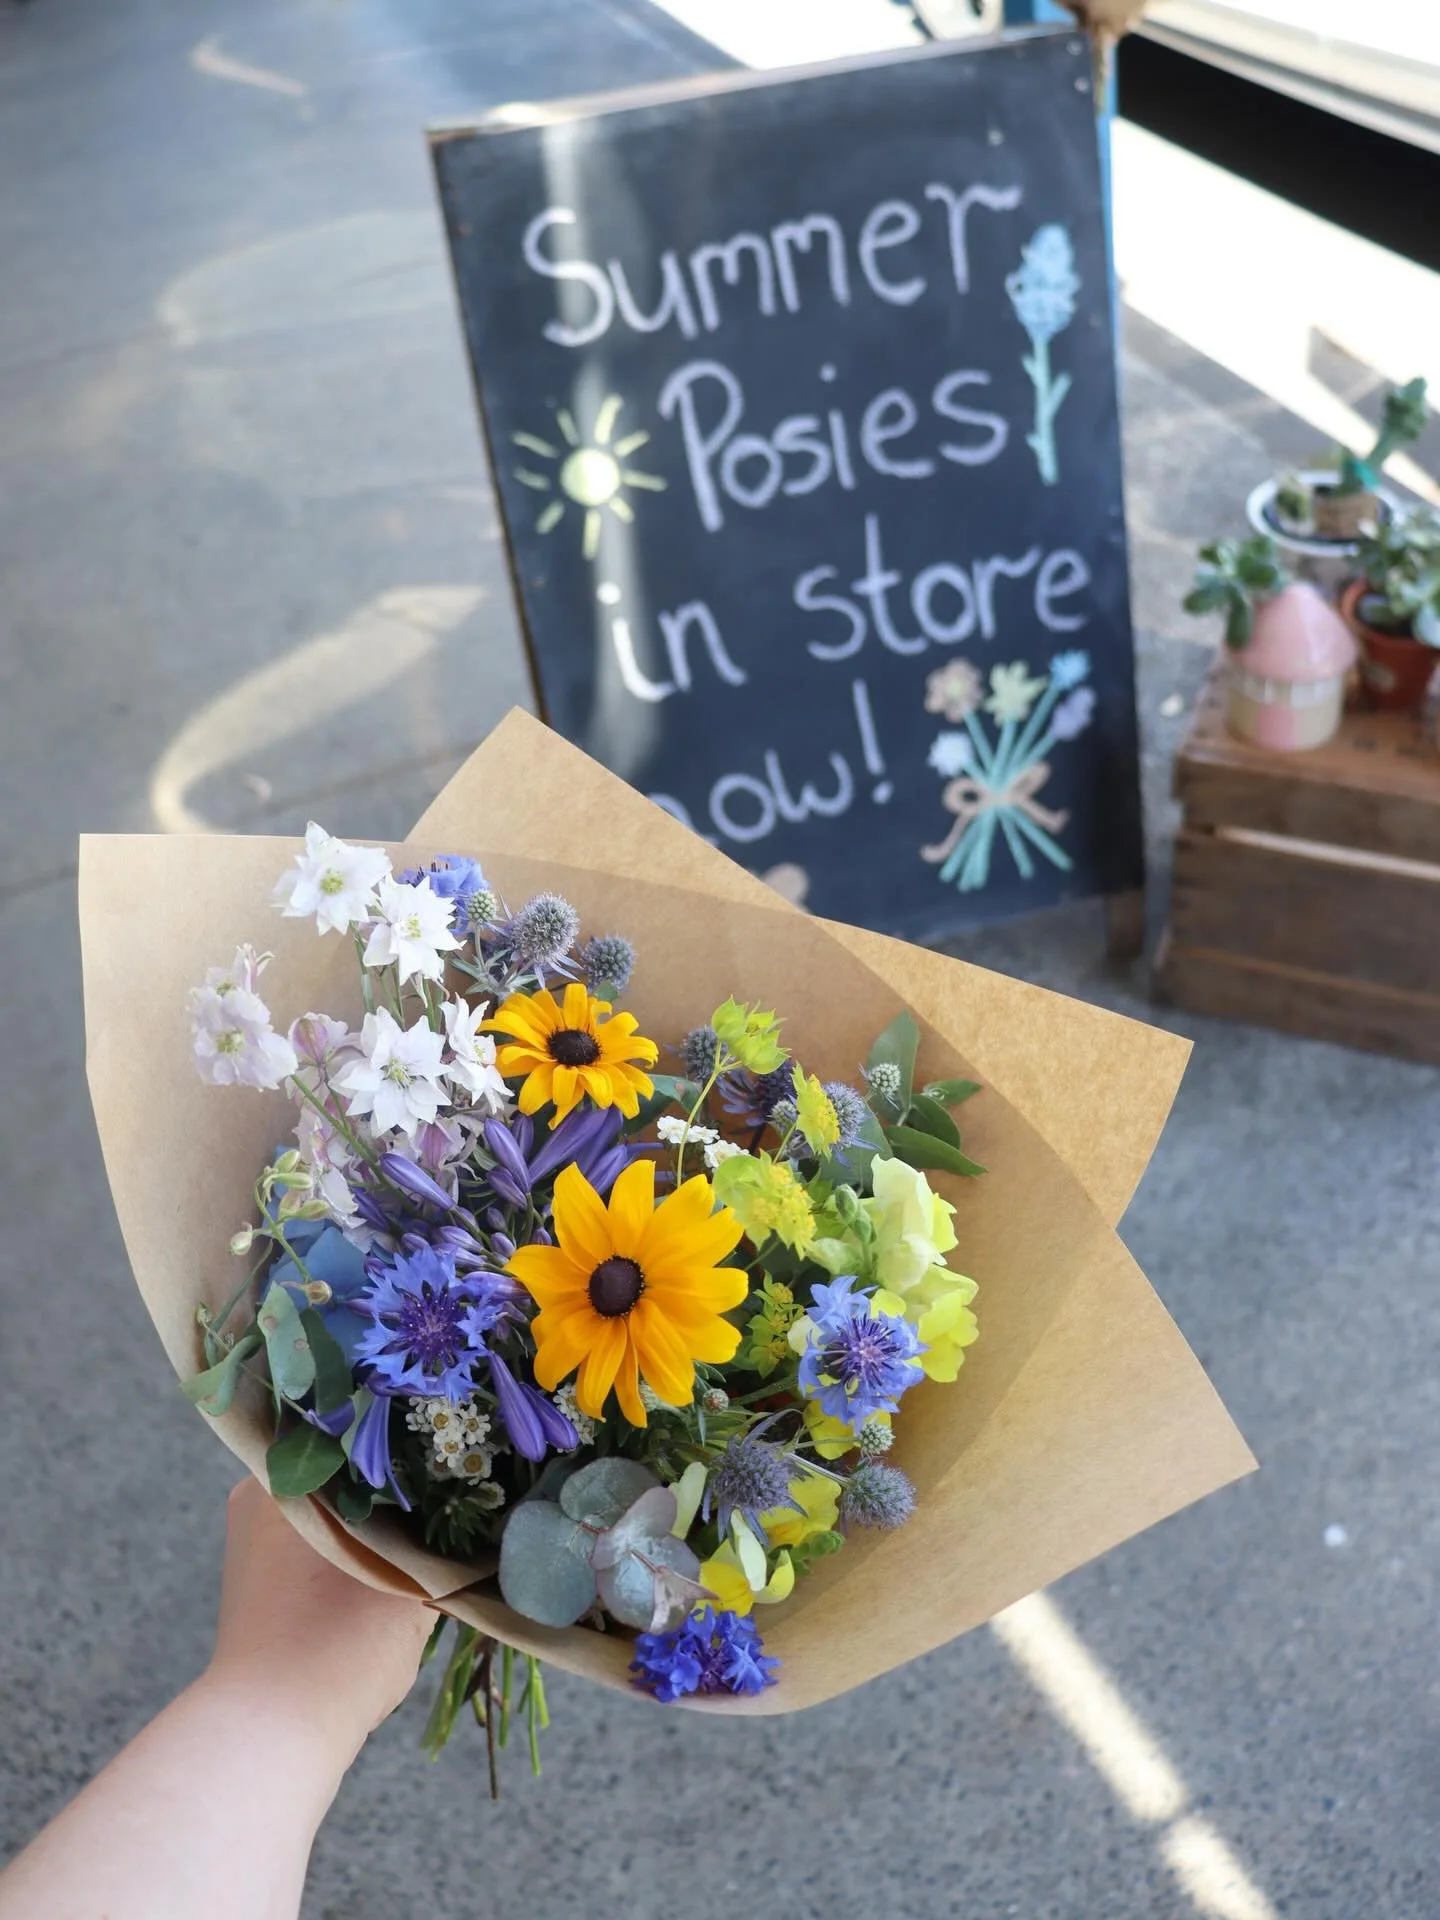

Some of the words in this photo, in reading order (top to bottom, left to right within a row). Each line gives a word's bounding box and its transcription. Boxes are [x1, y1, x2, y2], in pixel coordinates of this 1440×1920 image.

[523, 184, 1022, 347] Summer
[658, 360, 1010, 532] Posies
[598, 582, 748, 701] in
[794, 513, 1091, 661] store
